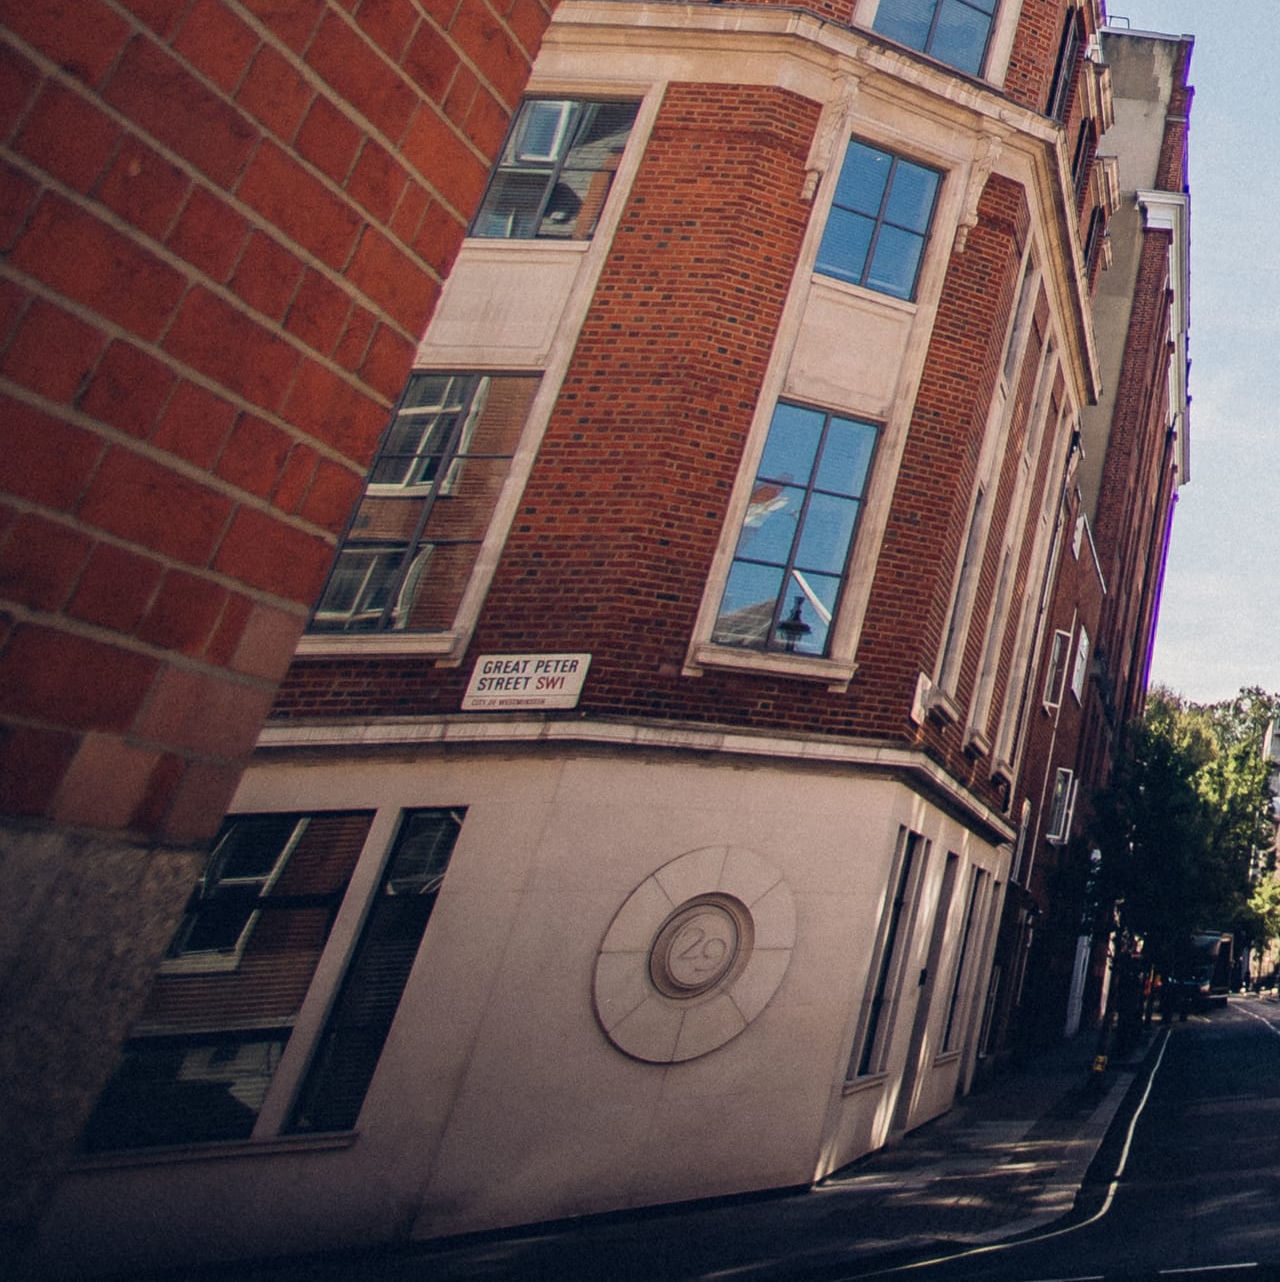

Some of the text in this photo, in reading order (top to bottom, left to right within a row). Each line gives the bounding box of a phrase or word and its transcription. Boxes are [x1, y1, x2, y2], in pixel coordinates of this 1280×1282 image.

[482, 659, 580, 675] GREAT PETER
[476, 675, 566, 691] STREET SW1
[676, 926, 728, 973] 29
